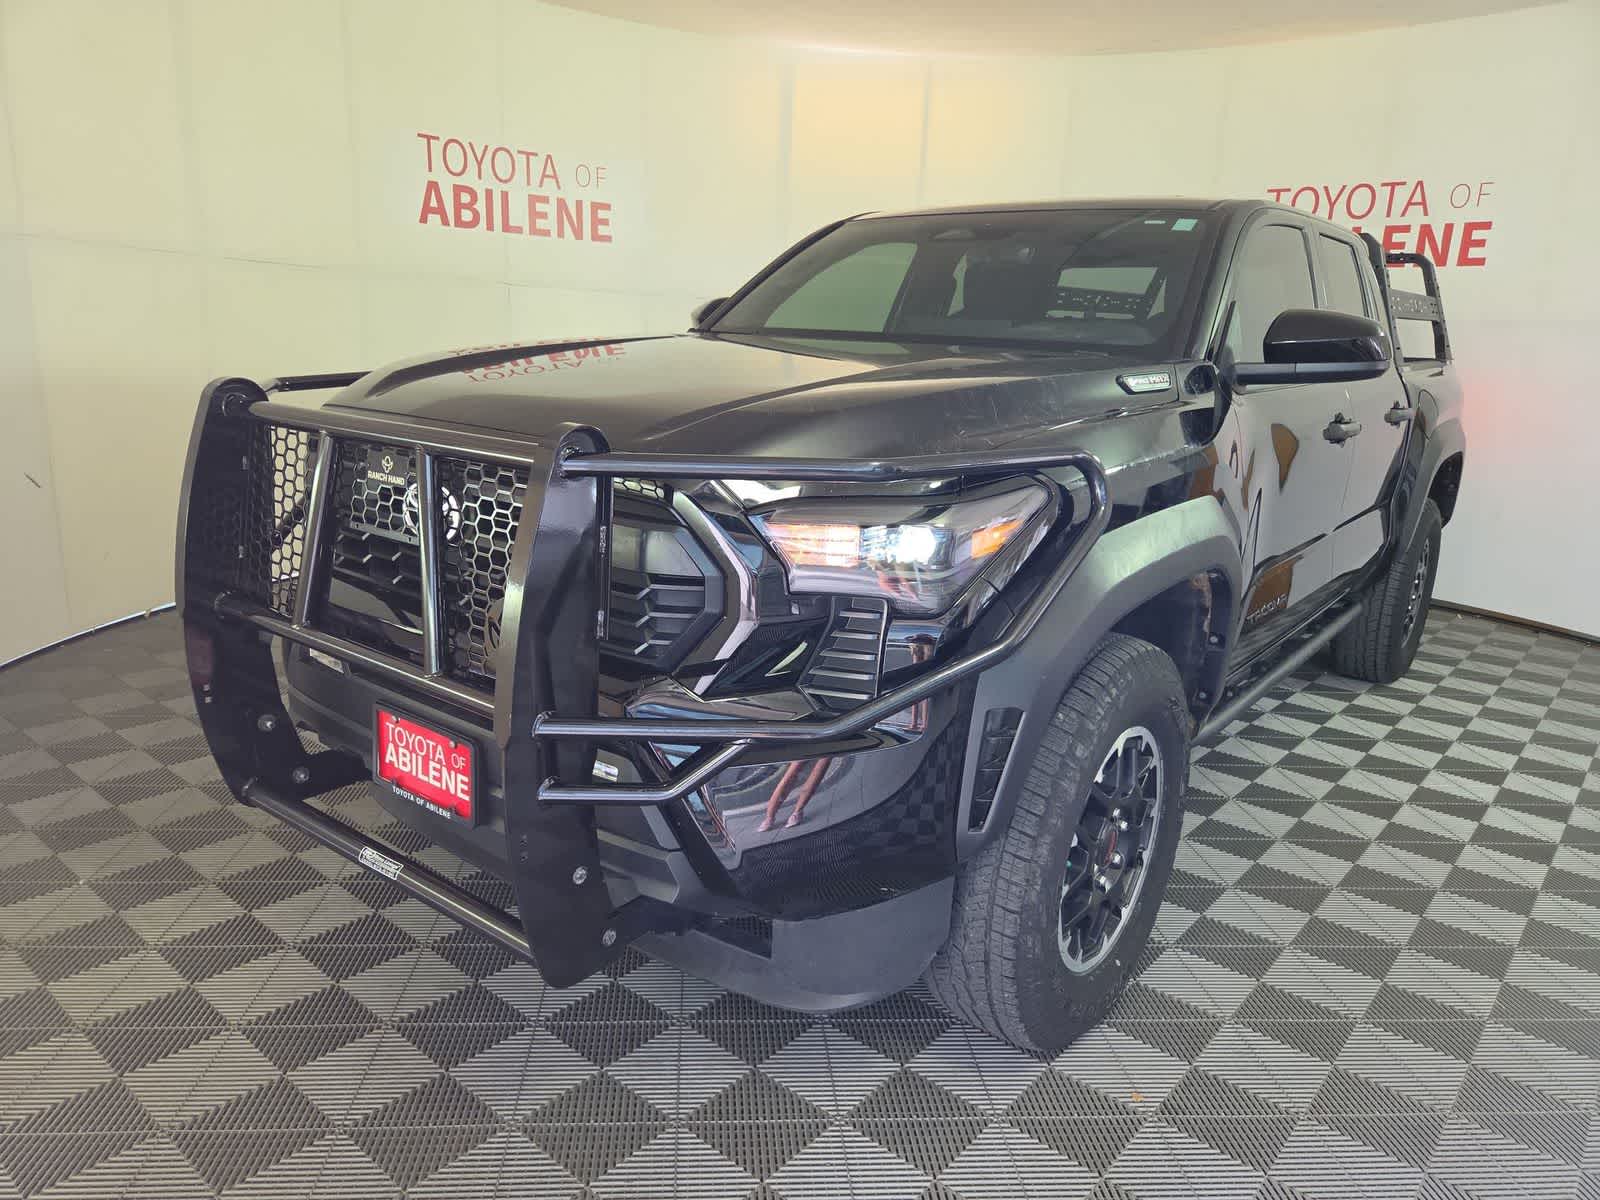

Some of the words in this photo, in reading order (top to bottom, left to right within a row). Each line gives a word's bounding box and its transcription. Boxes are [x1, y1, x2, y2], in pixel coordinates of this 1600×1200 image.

[417, 133, 561, 190] TOYOTA
[576, 164, 607, 189] OF
[419, 180, 613, 243] ABILENE
[1267, 180, 1429, 220] TOYOTA
[1450, 182, 1494, 208] OF
[367, 470, 387, 482] RANCH
[388, 475, 404, 485] HAND
[385, 722, 445, 766] TOYOTA
[451, 753, 466, 770] OF
[384, 743, 471, 802] ABILENE
[392, 785, 415, 802] TOYOTA
[416, 797, 425, 806] OF
[426, 802, 451, 820] ABILENE
